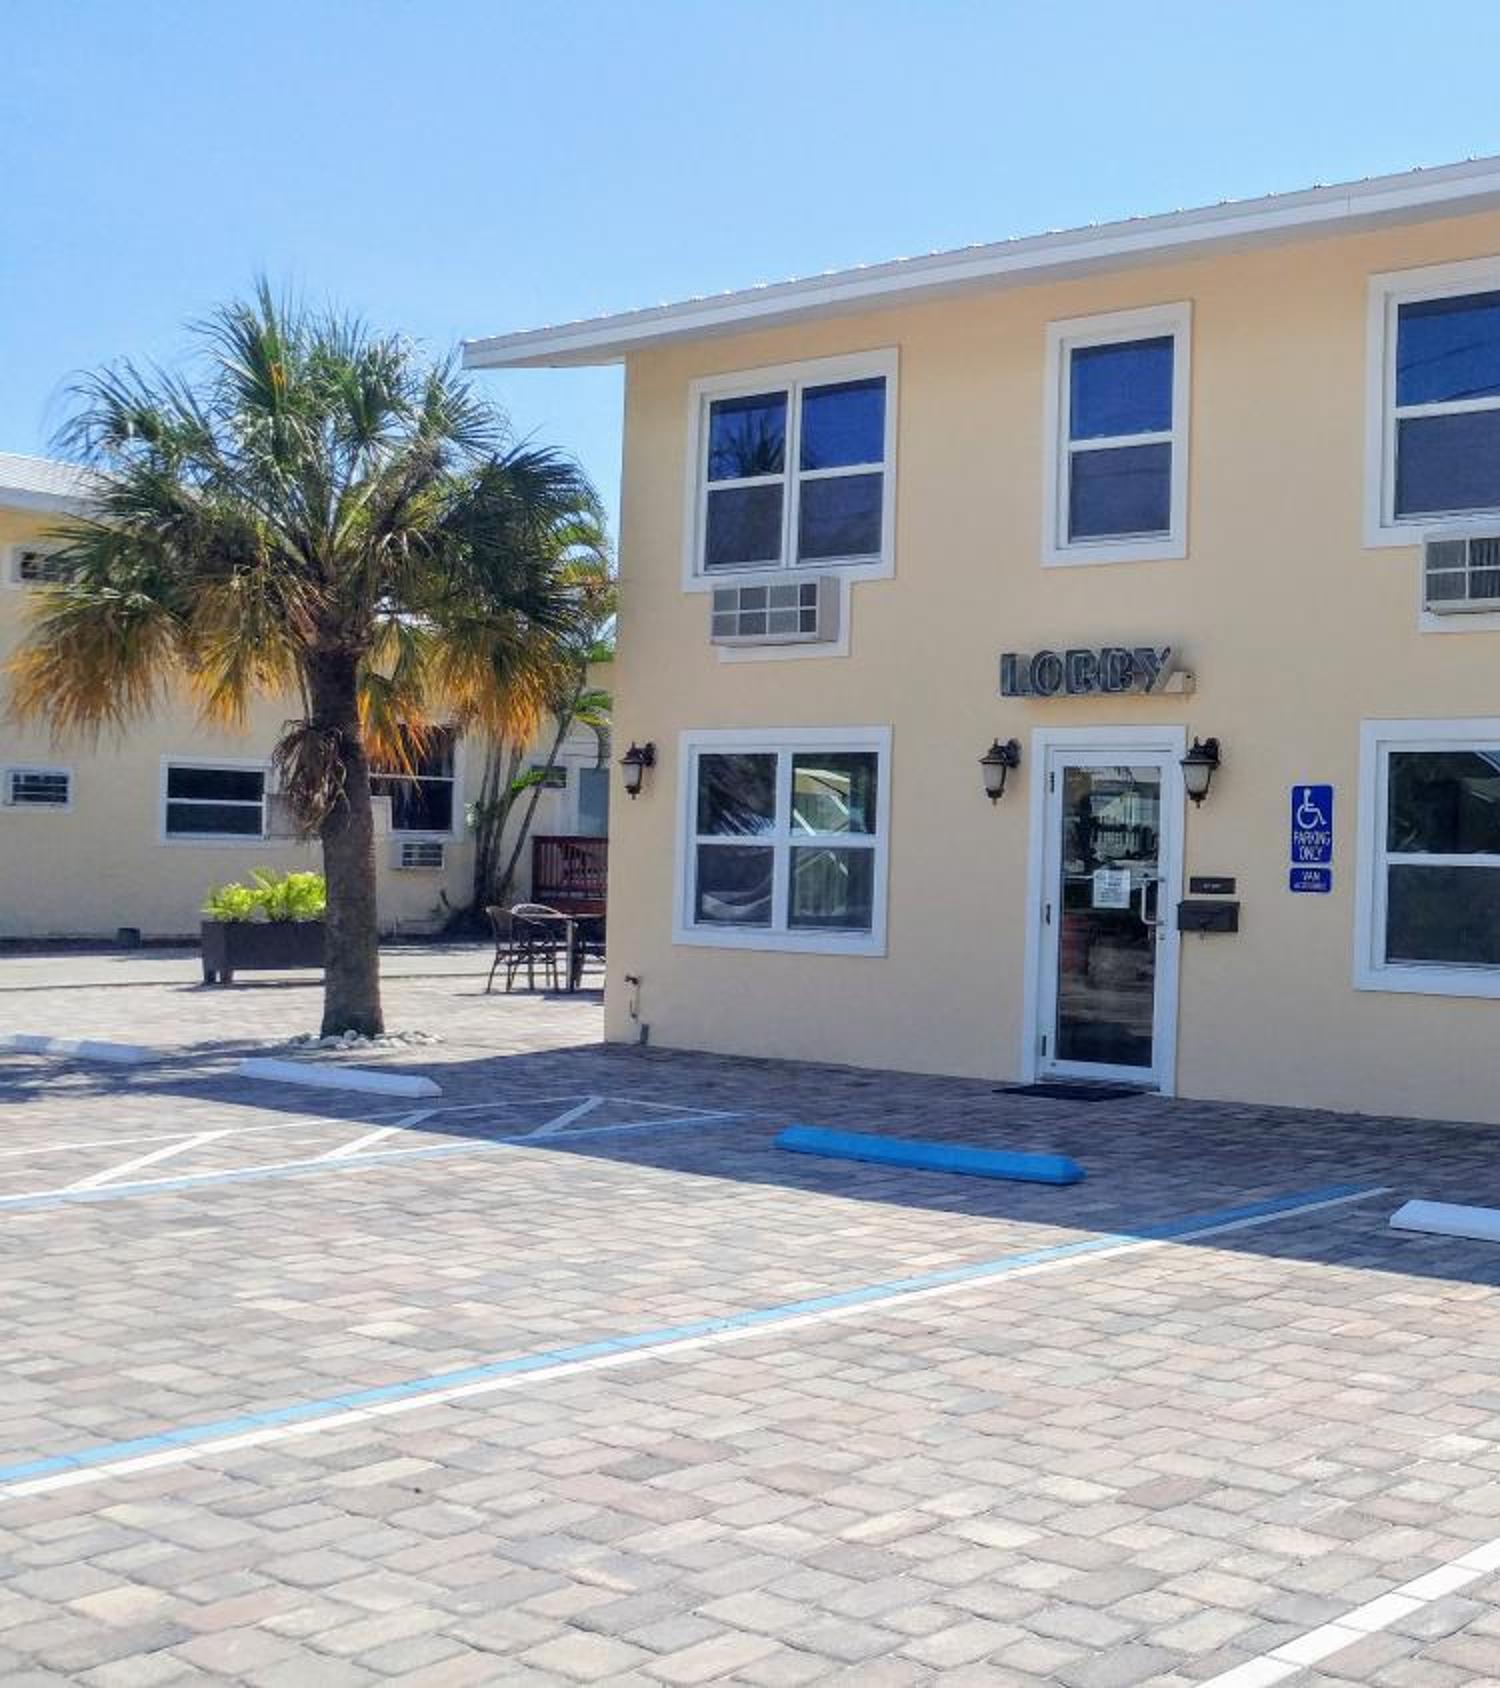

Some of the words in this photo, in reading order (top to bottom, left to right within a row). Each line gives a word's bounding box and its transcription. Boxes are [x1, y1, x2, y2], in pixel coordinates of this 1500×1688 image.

[1001, 647, 1171, 697] LOBBY
[1293, 831, 1331, 846] PARKING
[1299, 846, 1323, 861] ONLY
